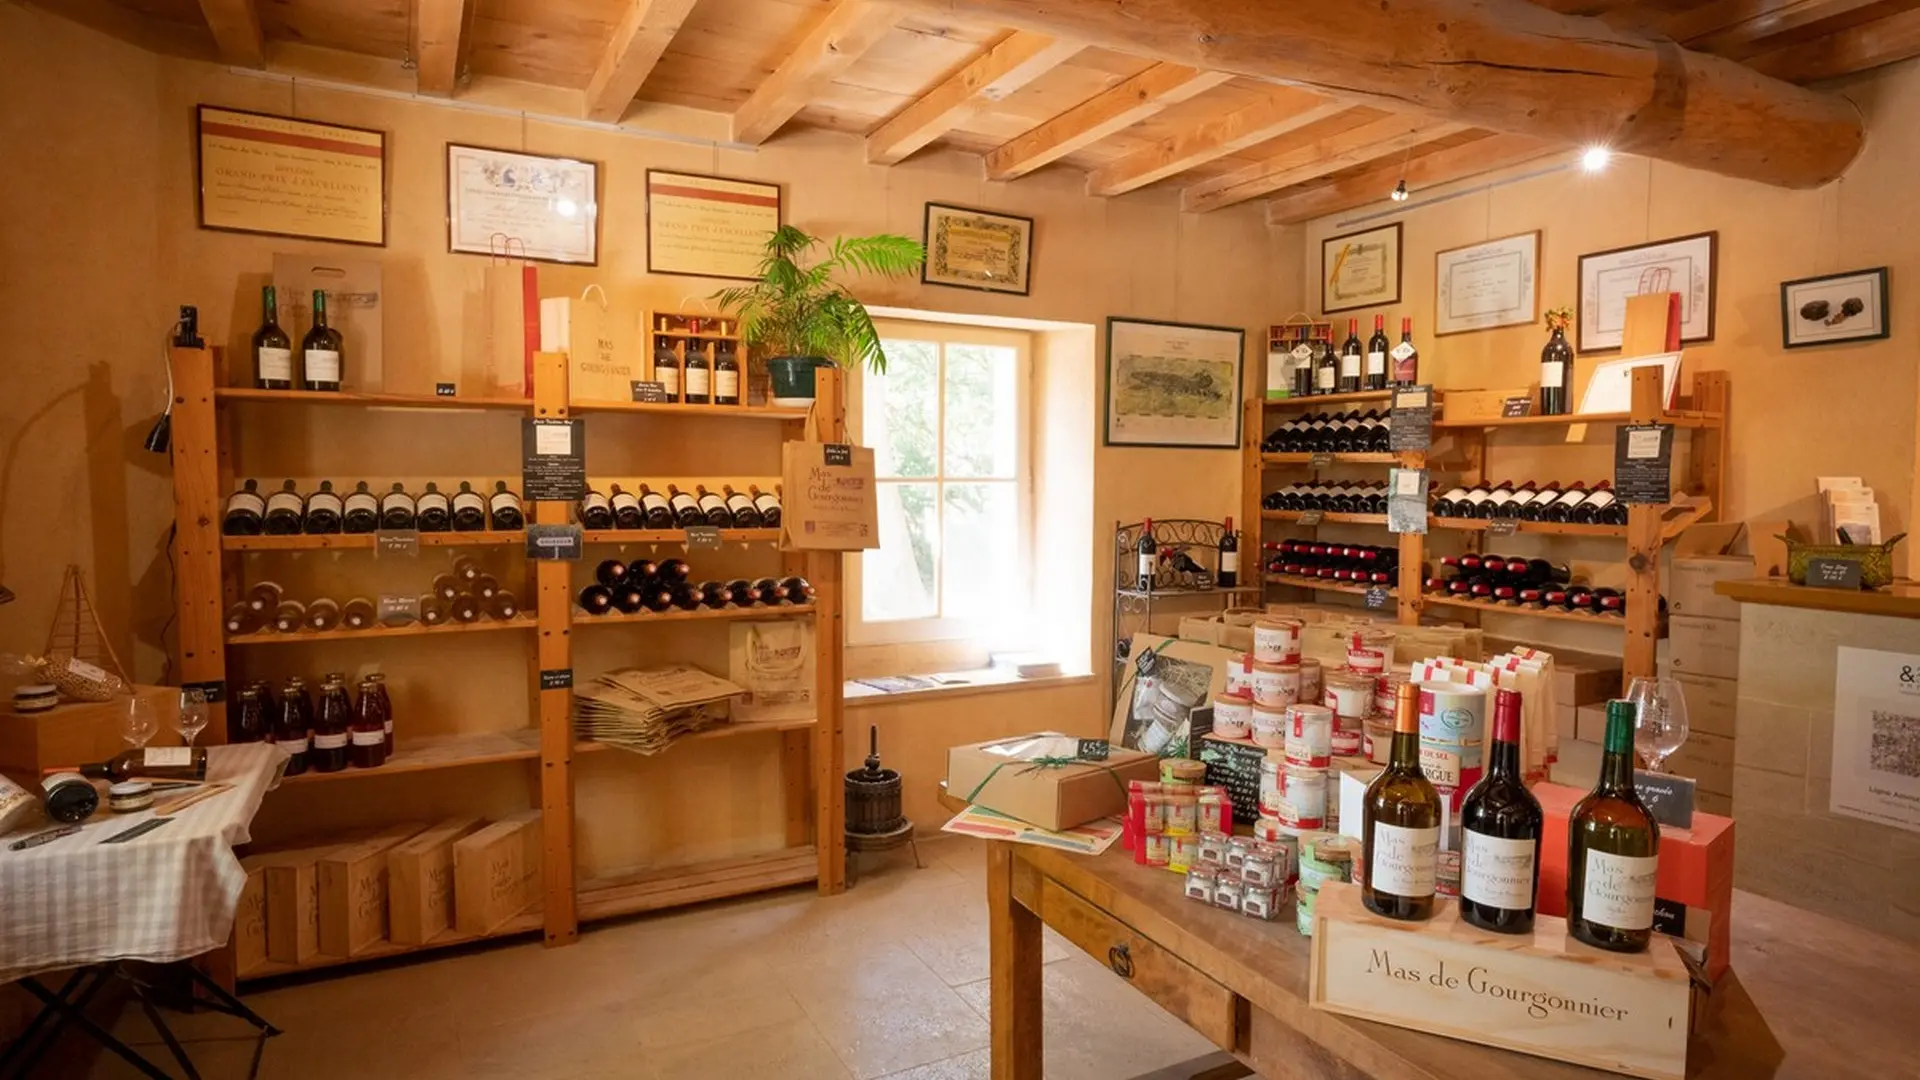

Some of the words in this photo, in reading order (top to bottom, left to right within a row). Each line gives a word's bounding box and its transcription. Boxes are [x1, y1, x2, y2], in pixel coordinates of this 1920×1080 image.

[1424, 767, 1454, 783] RGUE
[1591, 856, 1624, 875] Mas
[1603, 874, 1622, 892] de
[1367, 948, 1421, 983] Mas
[1429, 961, 1459, 990] de
[1467, 967, 1629, 1021] Gourgonnier
